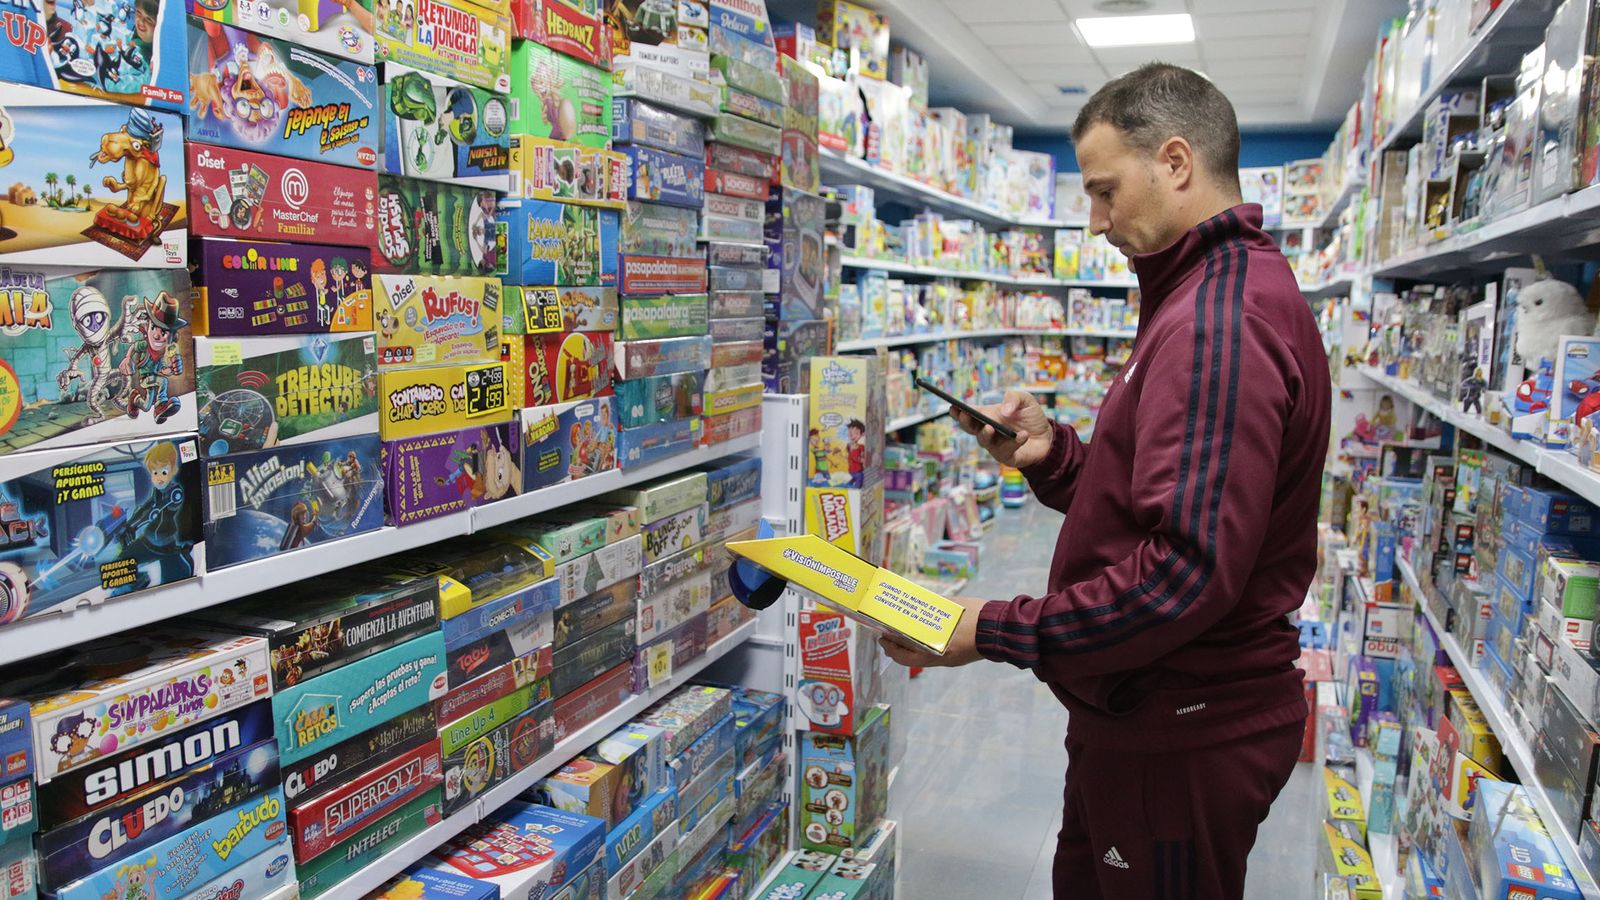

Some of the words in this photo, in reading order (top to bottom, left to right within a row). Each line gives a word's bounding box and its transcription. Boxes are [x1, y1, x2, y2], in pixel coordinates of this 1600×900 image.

[418, 0, 478, 35] RETUMBA
[546, 8, 595, 51] HEDBANZ
[720, 13, 749, 34] Deluxe
[418, 28, 433, 45] LA
[432, 27, 478, 56] JUNGLA
[142, 87, 168, 101] Family
[168, 92, 184, 102] Fun
[283, 104, 339, 140] abuela!
[338, 104, 351, 123] la
[198, 128, 220, 139] TOMY
[197, 150, 226, 170] Diset
[356, 151, 377, 162] BIZAK
[273, 208, 320, 223] MasterChef
[277, 223, 316, 236] Familiar
[223, 249, 267, 271] COLOR
[270, 257, 298, 271] LINE
[626, 260, 678, 277] pasapalabra
[28, 272, 45, 290] LA
[392, 278, 416, 306] Diset
[422, 286, 480, 326] RUFUS!
[624, 303, 689, 322] pasapalabra
[276, 363, 363, 393] TREASURE
[529, 361, 545, 407] UNO
[276, 385, 363, 418] DETECTOR
[389, 383, 445, 407] FONTANERO
[389, 400, 447, 423] CHAPUCERO
[239, 455, 281, 504] Alien
[250, 460, 305, 510] Invasion!
[57, 488, 71, 504] ¡Y
[72, 484, 105, 501] GANA!
[820, 492, 838, 542] MOJADA
[832, 494, 849, 534] CABEZA
[653, 535, 669, 557] OFF
[108, 574, 137, 588] GANHA!
[874, 594, 902, 612] CONVIERTE
[881, 590, 901, 602] PATAS
[920, 609, 934, 619] TODO
[910, 595, 929, 608] MUNDO
[936, 608, 952, 619] PONE
[345, 616, 386, 648] COMIENZA
[386, 613, 397, 628] LA
[397, 599, 435, 624] AVENTURA
[816, 618, 839, 633] DON
[137, 673, 211, 717] PALABRAS
[349, 685, 375, 714] ¡Supera
[375, 677, 386, 692] las
[386, 661, 413, 687] pruebas
[419, 655, 437, 670] gana!
[368, 686, 398, 715] ¿Aceptas
[404, 670, 422, 689] reto?
[175, 698, 205, 720] JUNIOR
[1176, 702, 1207, 716] AEROREADY
[298, 714, 339, 748] RETOS
[402, 714, 427, 735] Potter
[450, 725, 471, 745] Line
[472, 715, 486, 732] Up
[488, 707, 495, 720] 4
[285, 753, 338, 799] CLUEDO
[329, 764, 415, 827] SUPERPOLY
[87, 786, 185, 860] CLUEDO
[211, 794, 281, 862] barbudo
[347, 817, 402, 860] INTELECT
[1103, 856, 1130, 870] adidas
